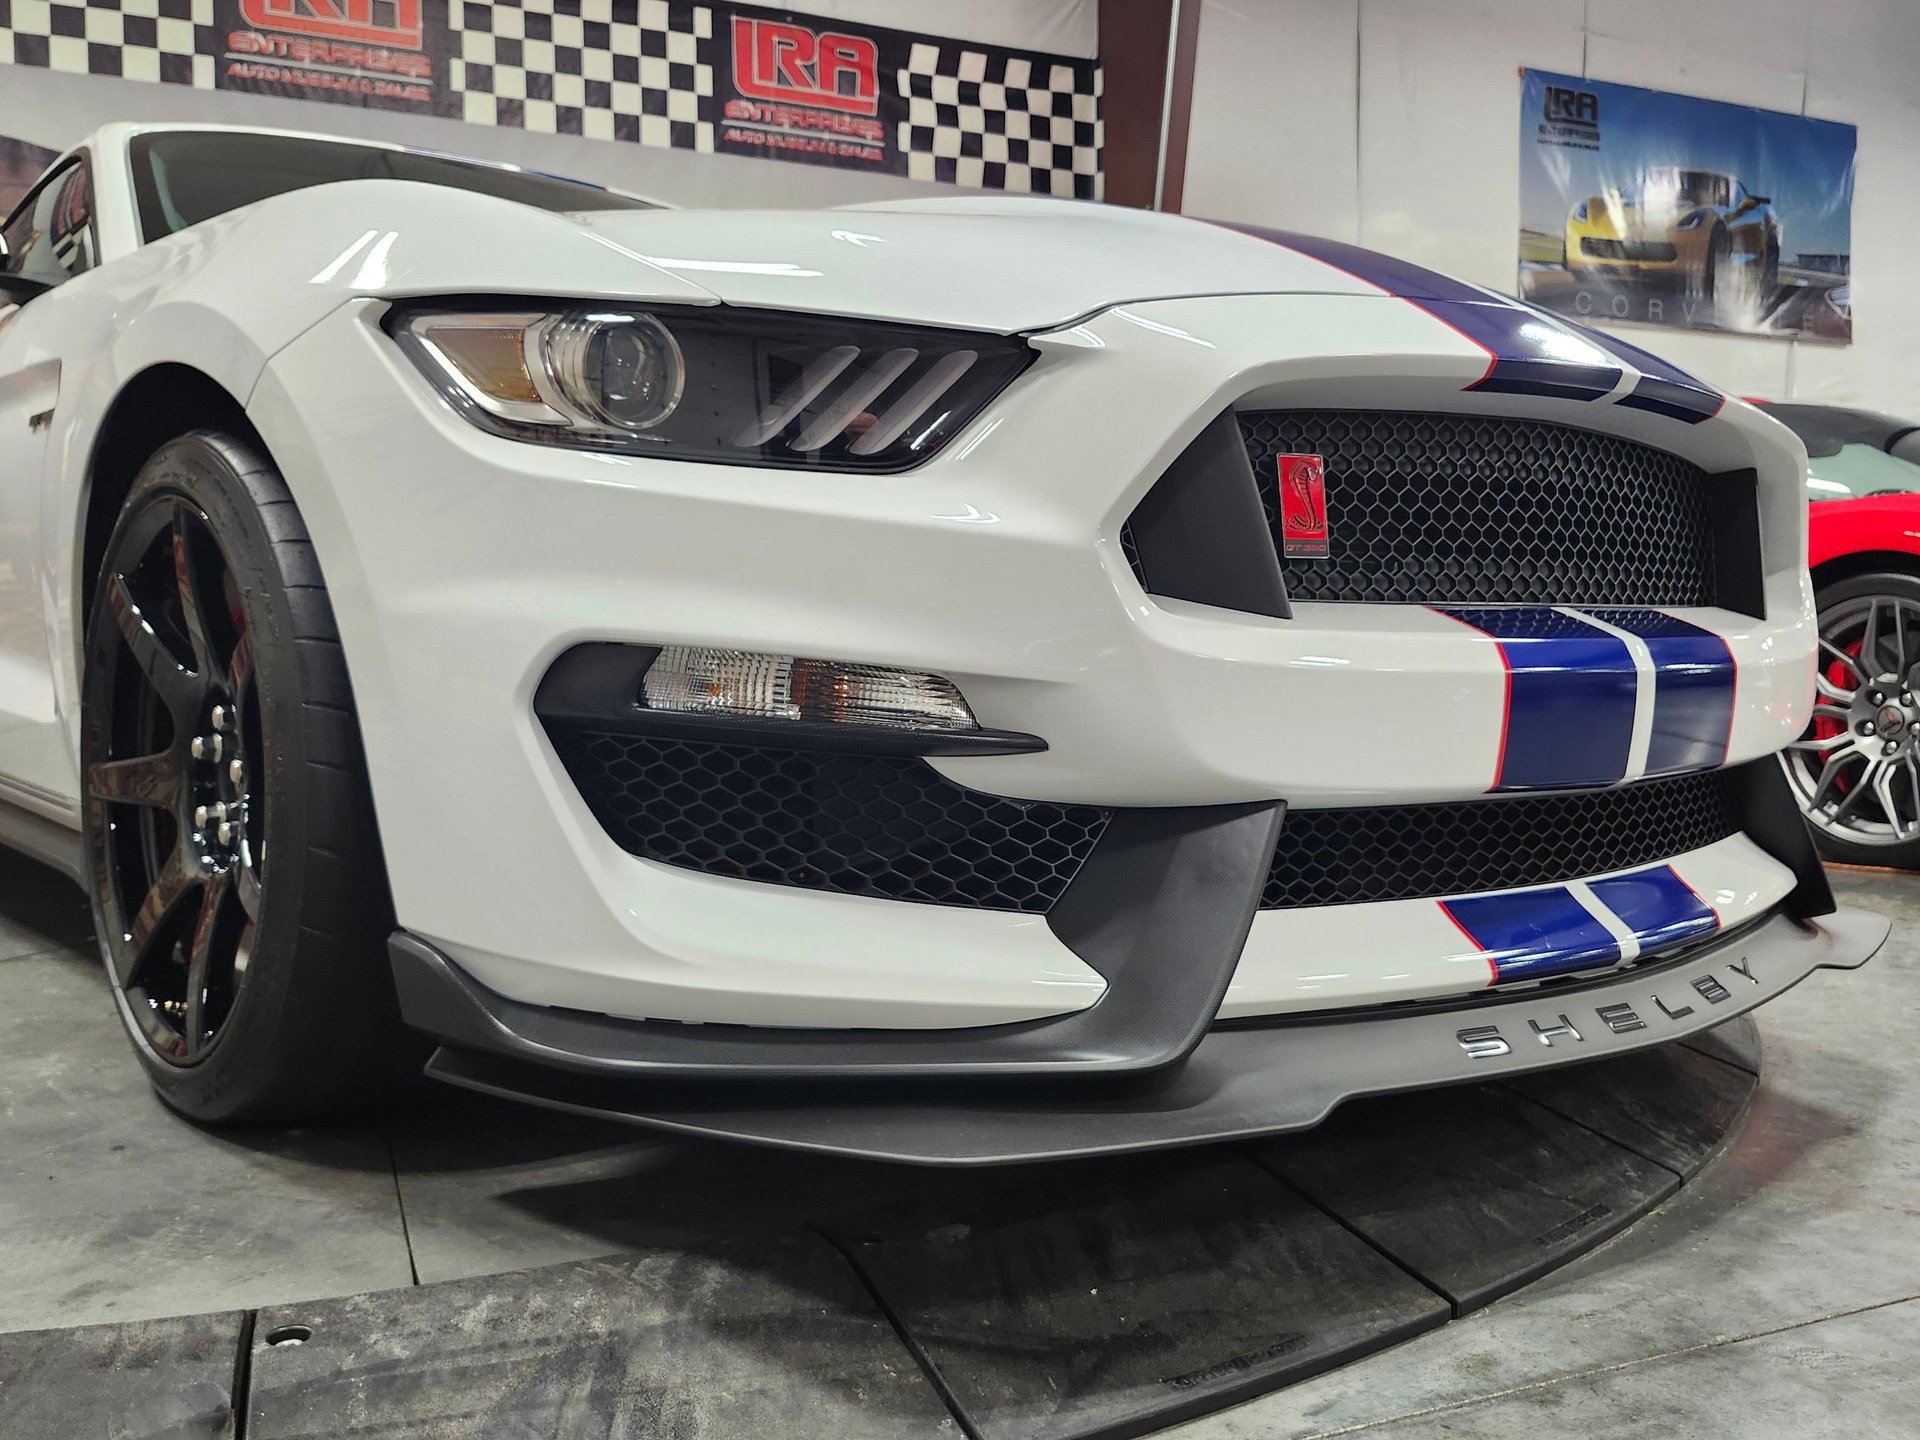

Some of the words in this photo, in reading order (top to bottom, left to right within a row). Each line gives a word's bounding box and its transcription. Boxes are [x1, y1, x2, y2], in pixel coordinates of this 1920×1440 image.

[227, 63, 279, 81] AUTO
[731, 15, 880, 117] LRA
[1544, 86, 1598, 127] LRA
[1456, 956, 1759, 1060] SHELBY
